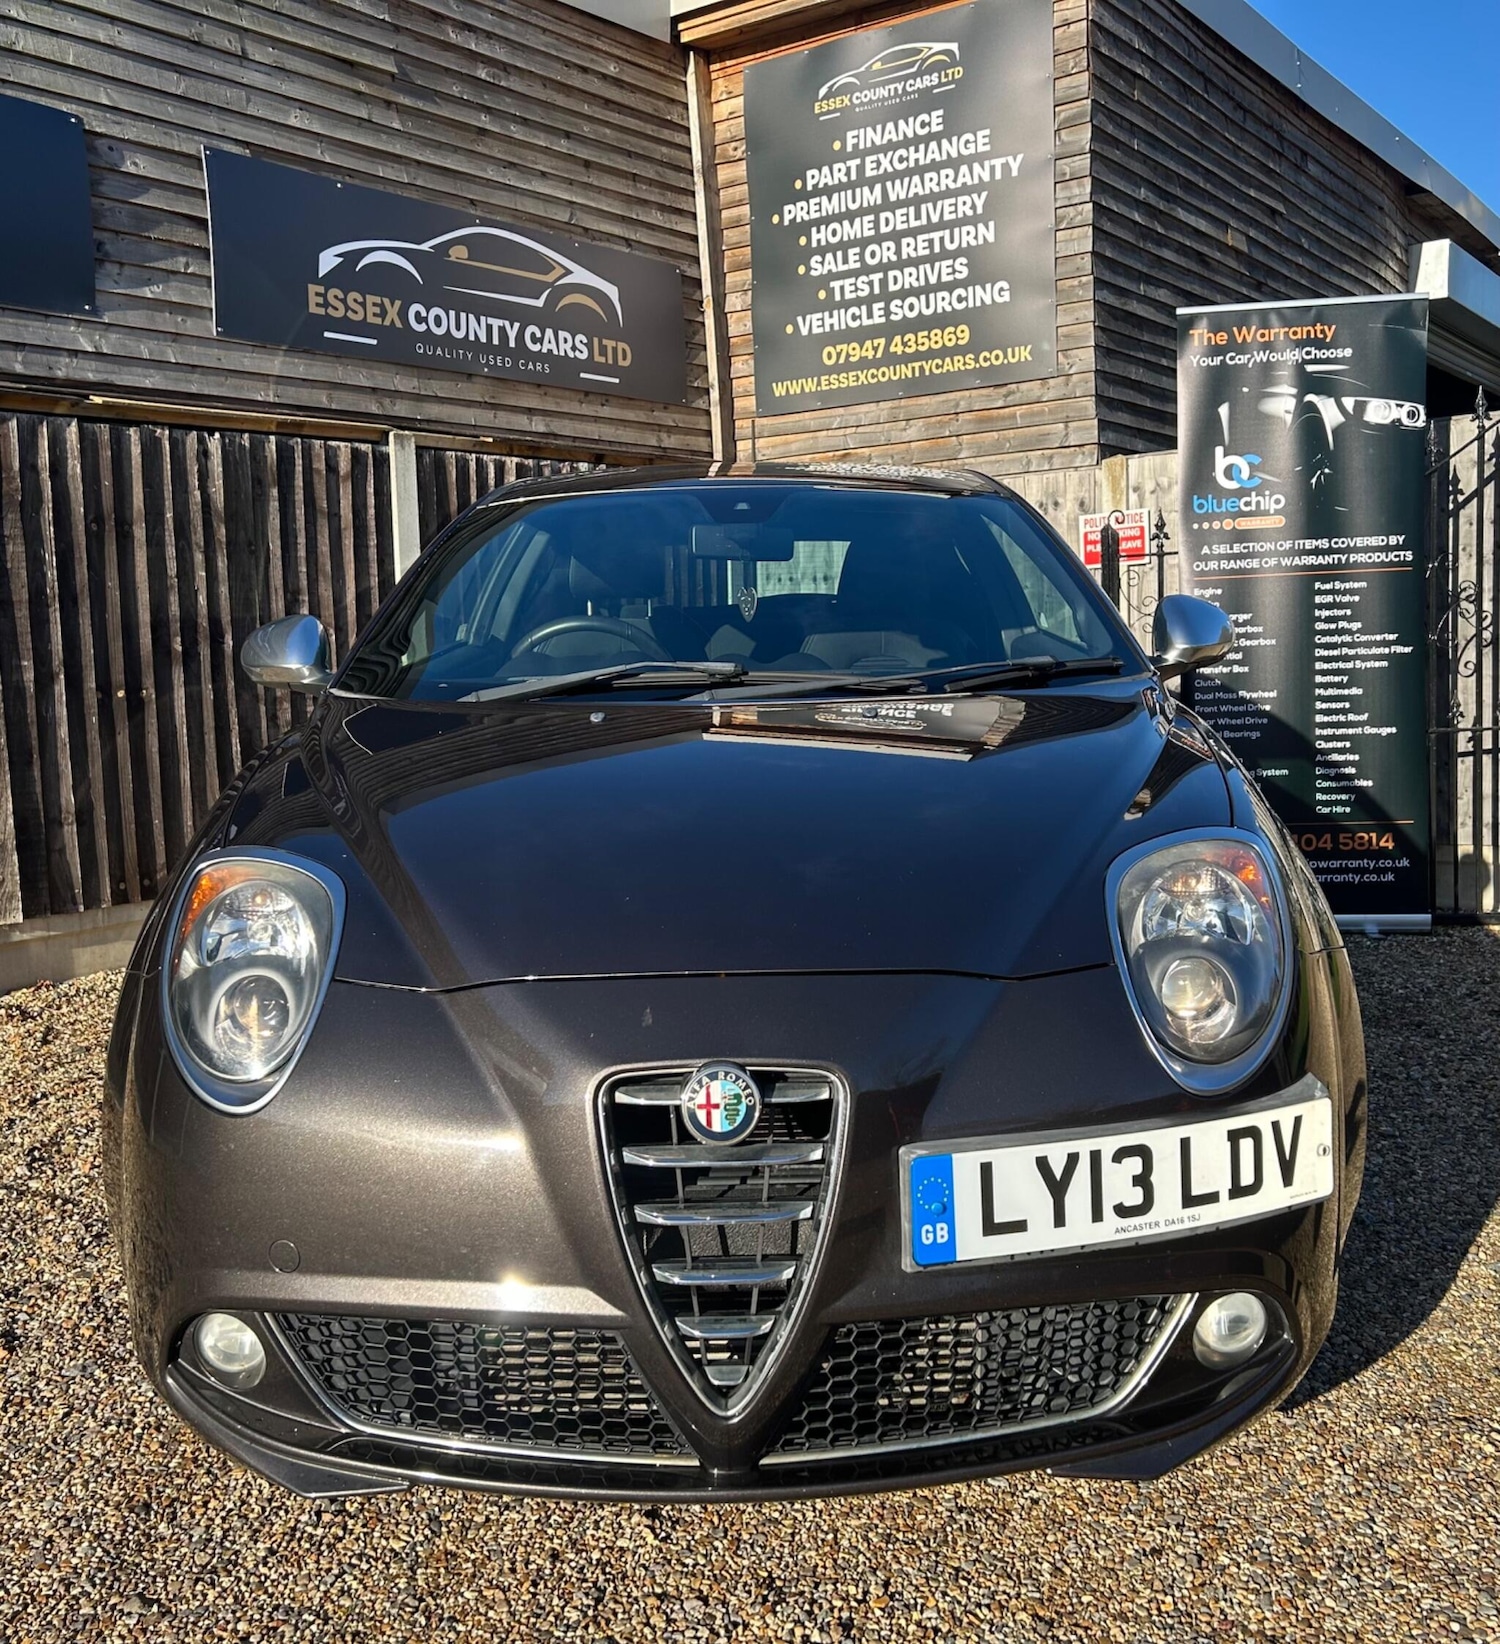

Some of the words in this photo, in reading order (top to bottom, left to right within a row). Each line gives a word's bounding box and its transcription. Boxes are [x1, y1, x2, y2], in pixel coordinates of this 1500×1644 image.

[814, 94, 851, 114] ESSEX
[852, 81, 906, 105] COUNTY
[906, 73, 939, 92] CARS
[940, 66, 964, 83] LTD
[855, 102, 882, 112] QUALITY
[902, 93, 919, 102] CARS
[846, 109, 944, 152] FINANCE
[806, 159, 862, 191] PART
[865, 128, 991, 178] EXCHANGE
[783, 183, 882, 226] PREMIUM
[885, 153, 1024, 201] WARRANTY
[810, 219, 874, 248] HOME
[879, 190, 988, 234] DELIVERY
[809, 247, 861, 277] SALE
[864, 240, 898, 266] OR
[901, 220, 995, 260] RETURN
[829, 273, 884, 302] TEST
[888, 256, 969, 292] DRIVES
[796, 302, 886, 336] VEHICLE
[889, 280, 1011, 321] SOURCING
[307, 283, 403, 328] ESSEX
[407, 303, 521, 348] COUNTY
[524, 325, 589, 360] CARS
[592, 336, 632, 367] LTD
[1189, 328, 1229, 346] The
[1232, 322, 1337, 343] Warranty
[822, 337, 887, 366] 07947
[889, 323, 971, 356] 435869
[416, 343, 474, 361] QUALITY
[480, 354, 512, 368] USED
[519, 360, 551, 374] CARS
[1189, 354, 1224, 367] Your
[1253, 348, 1300, 363] Would
[1301, 346, 1353, 360] Choose
[772, 344, 1033, 397] WWW.ESSEXCOUNTYCARS.CO.UK
[1193, 490, 1286, 514] bluechip
[1084, 517, 1108, 529] POLIT
[1201, 545, 1211, 555] A
[1211, 541, 1274, 554] SELECTION
[1276, 540, 1293, 550] OF
[1294, 538, 1329, 550] ITEMS
[1331, 536, 1387, 548] COVERED
[1388, 535, 1405, 546] BY
[1193, 561, 1219, 571] OUR
[1220, 558, 1260, 570] RANGE
[1261, 557, 1278, 567] OF
[1279, 554, 1348, 567] WARRANTY
[1349, 551, 1413, 563] PRODUCTS
[1314, 581, 1333, 590] Fuel
[1334, 581, 1367, 591] System
[1193, 587, 1223, 597] Engine
[1314, 595, 1333, 603] EGR
[1334, 594, 1360, 602] Valve
[1314, 608, 1352, 619] Injectors
[1314, 622, 1337, 630] Glow
[1338, 621, 1362, 631] Plugs
[1239, 638, 1276, 646] Gearbox
[1314, 634, 1353, 644] Catalytic
[1354, 633, 1399, 641] Converter
[1314, 648, 1341, 656] Diesel
[1342, 646, 1389, 656] Particulate
[1390, 645, 1413, 654] Filter
[1232, 664, 1249, 673] Box
[1314, 661, 1354, 670] Electrical
[1355, 660, 1388, 670] System
[1194, 679, 1221, 687] Clutch
[1315, 674, 1348, 683] Battery
[1194, 692, 1213, 700] Dual
[1238, 689, 1277, 700] Flywheel
[1315, 687, 1363, 696] Multimedia
[1219, 704, 1246, 712] Wheel
[1247, 703, 1271, 711] Drive
[1315, 701, 1350, 709] Sensors
[1217, 717, 1244, 725] Wheel
[1315, 714, 1347, 722] Electric
[1347, 712, 1369, 721] Roof
[1223, 730, 1260, 739] Bearings
[1315, 727, 1362, 735] Instrument
[1363, 726, 1397, 736] Gauges
[1315, 740, 1351, 749] Clusters
[1315, 753, 1360, 761] Ancillaries
[1256, 768, 1289, 777] System
[1315, 766, 1357, 776] Diagnosis
[1315, 778, 1373, 787] Consumables
[1315, 793, 1356, 802] Recovery
[1332, 805, 1351, 813] Hire
[1339, 832, 1395, 850] 5814
[686, 1076, 712, 1109] ALFA
[717, 1071, 755, 1106] ROMEO
[979, 1143, 1154, 1238] LY13
[1179, 1114, 1304, 1209] LDV
[1114, 1221, 1161, 1235] ANCASTER
[1164, 1216, 1185, 1227] DA16
[1187, 1213, 1201, 1223] 1SJ
[920, 1222, 950, 1246] GB
